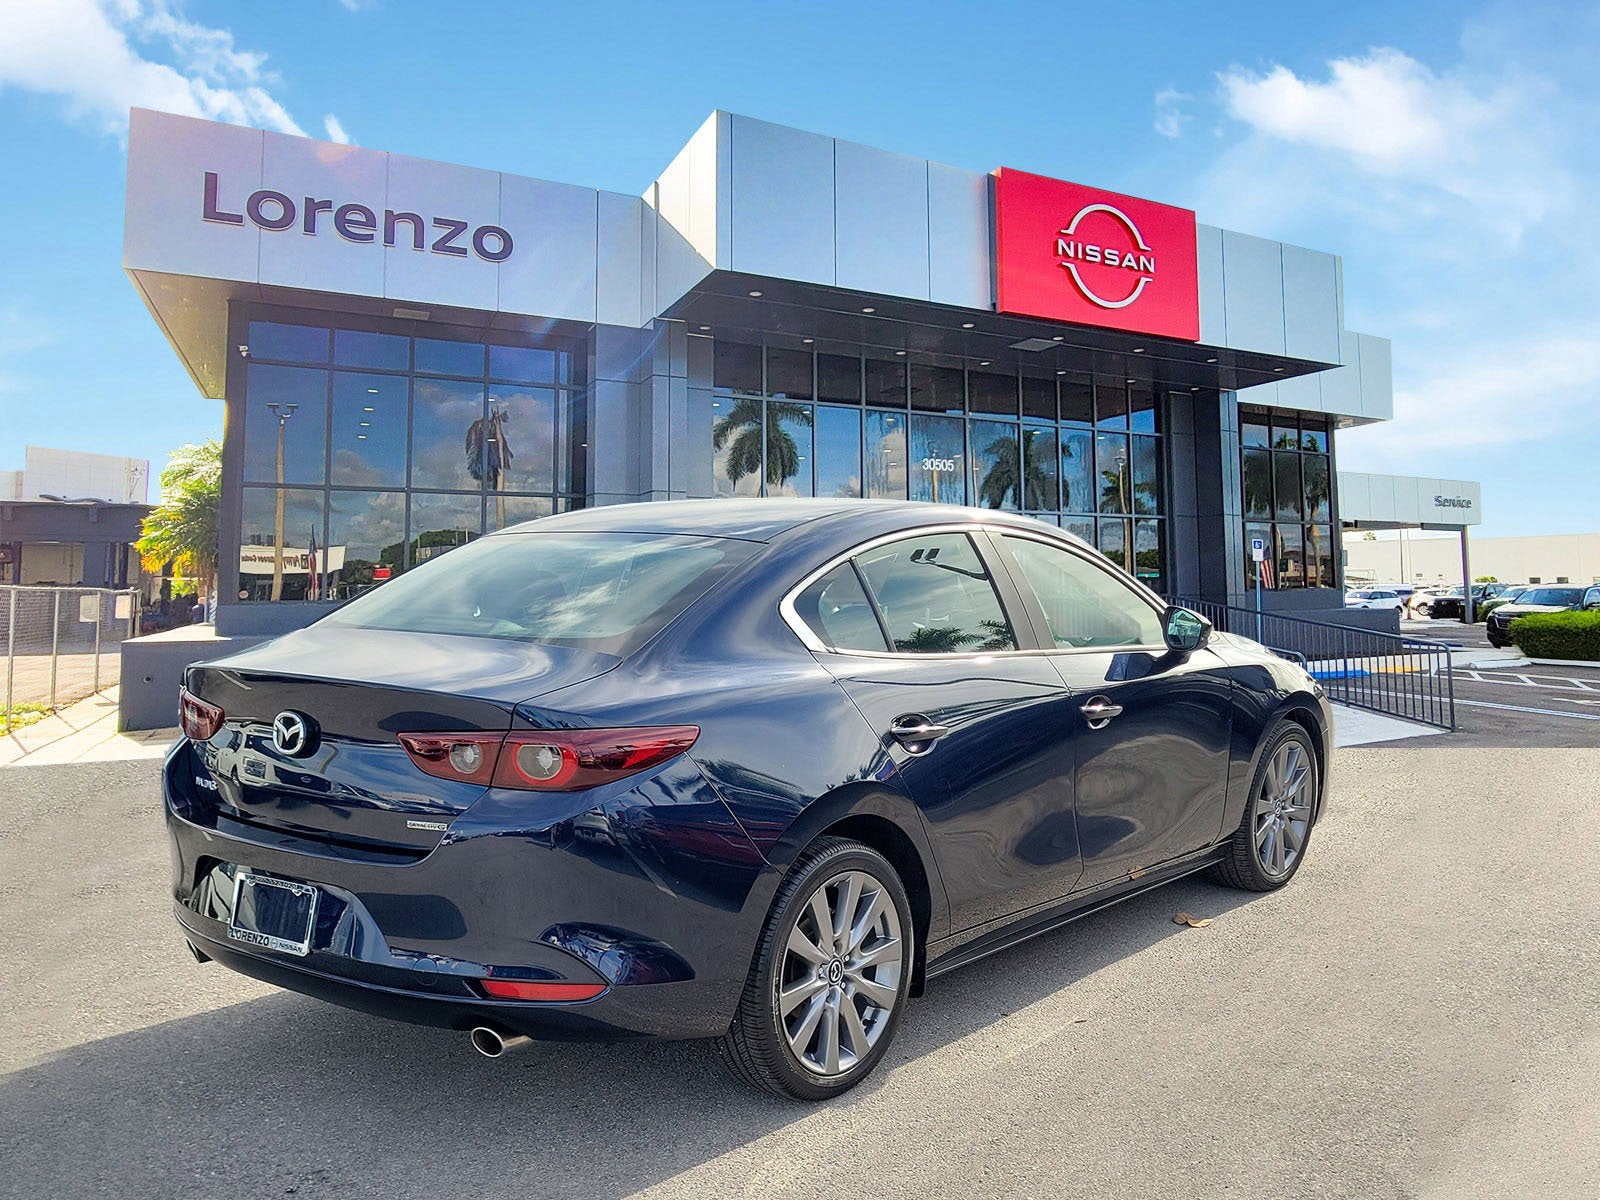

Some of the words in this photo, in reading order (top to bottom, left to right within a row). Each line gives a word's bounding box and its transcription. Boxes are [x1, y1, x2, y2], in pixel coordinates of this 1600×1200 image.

[202, 171, 514, 263] Lorenzo
[1057, 238, 1155, 273] NISSAN
[922, 457, 955, 472] 30505
[1434, 495, 1472, 509] Service
[230, 929, 270, 947] LORENZO
[278, 942, 303, 953] NISSAN
